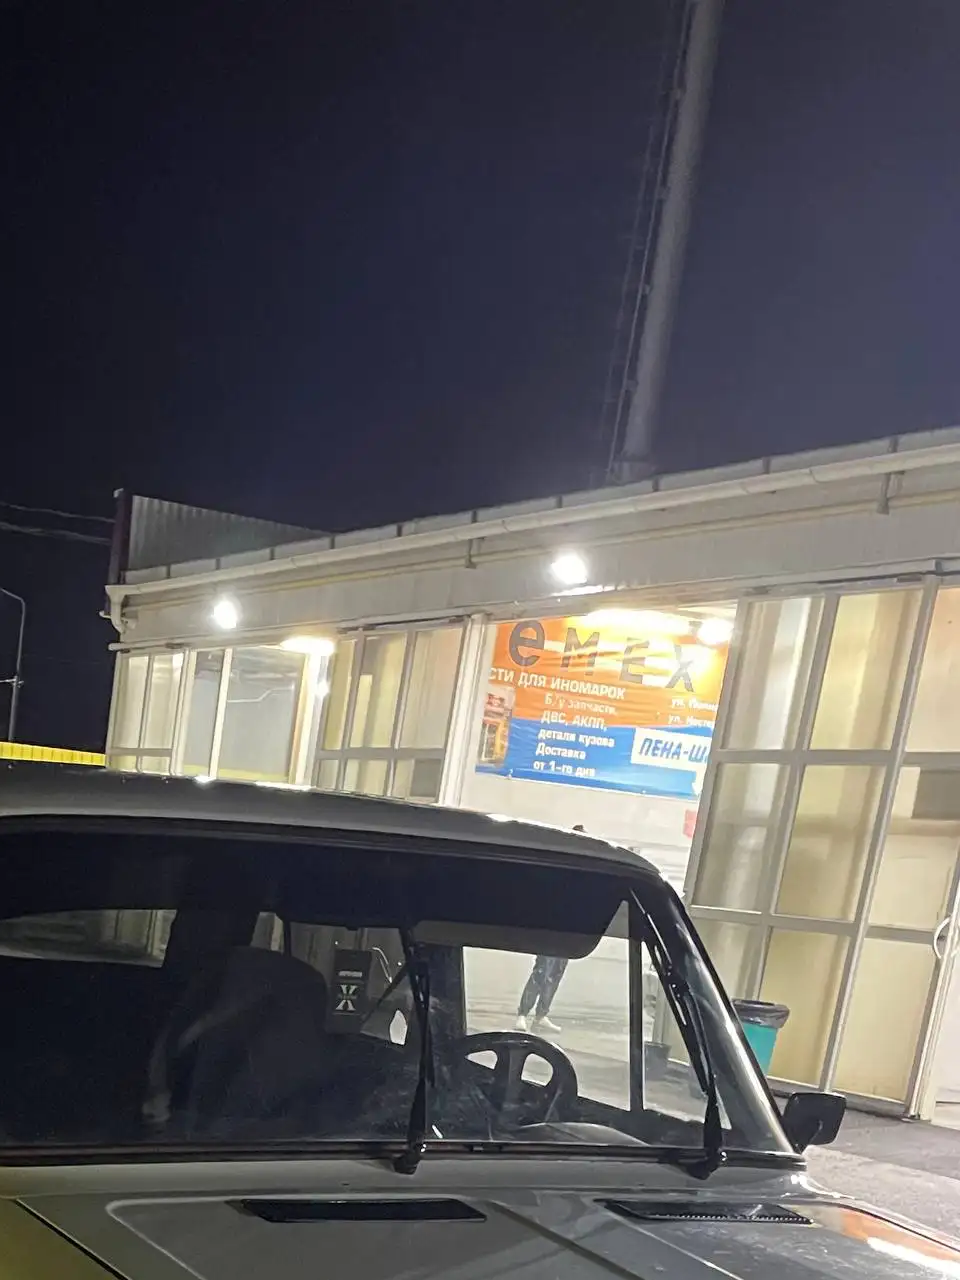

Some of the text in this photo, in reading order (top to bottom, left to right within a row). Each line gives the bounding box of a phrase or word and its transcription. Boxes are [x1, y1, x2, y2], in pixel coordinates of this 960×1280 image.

[518, 672, 546, 688] ДЛЯ
[551, 678, 626, 699] ИНОМАРОК
[540, 711, 608, 732] ДВС, АКПП,
[538, 728, 615, 748] детали кузова
[535, 742, 587, 760] Доставка
[640, 737, 708, 764] ПЕНА-Ш
[533, 760, 545, 771] от
[548, 760, 573, 774] 1-го
